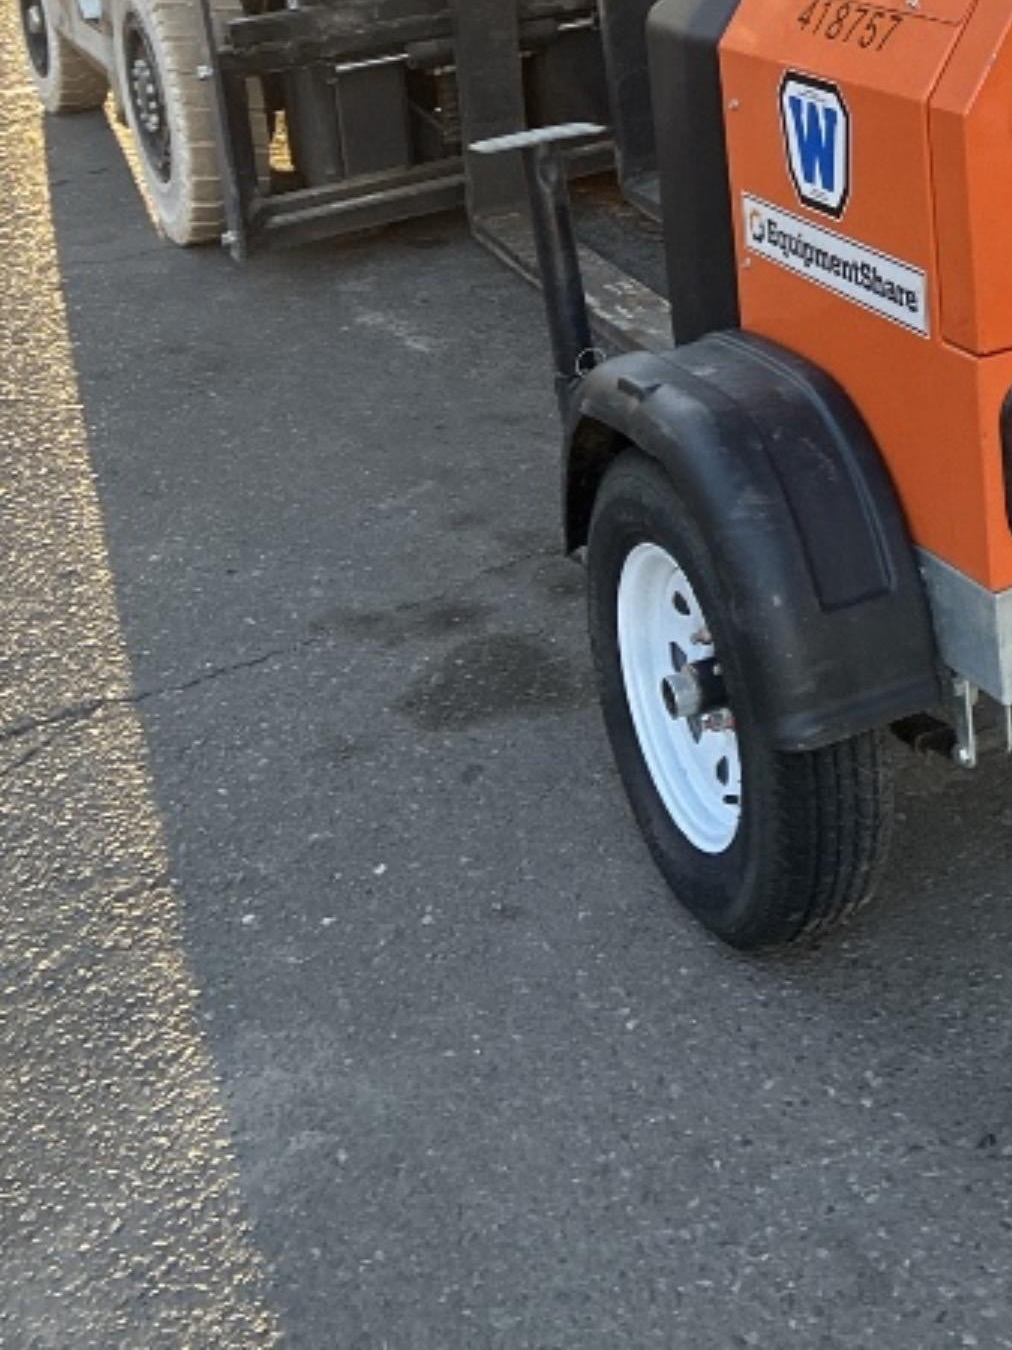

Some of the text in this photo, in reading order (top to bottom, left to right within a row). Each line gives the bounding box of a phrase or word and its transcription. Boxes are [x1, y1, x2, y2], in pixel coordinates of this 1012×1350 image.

[796, 0, 903, 52] 418757
[788, 95, 838, 193] W
[766, 219, 919, 313] EquipmentShare
